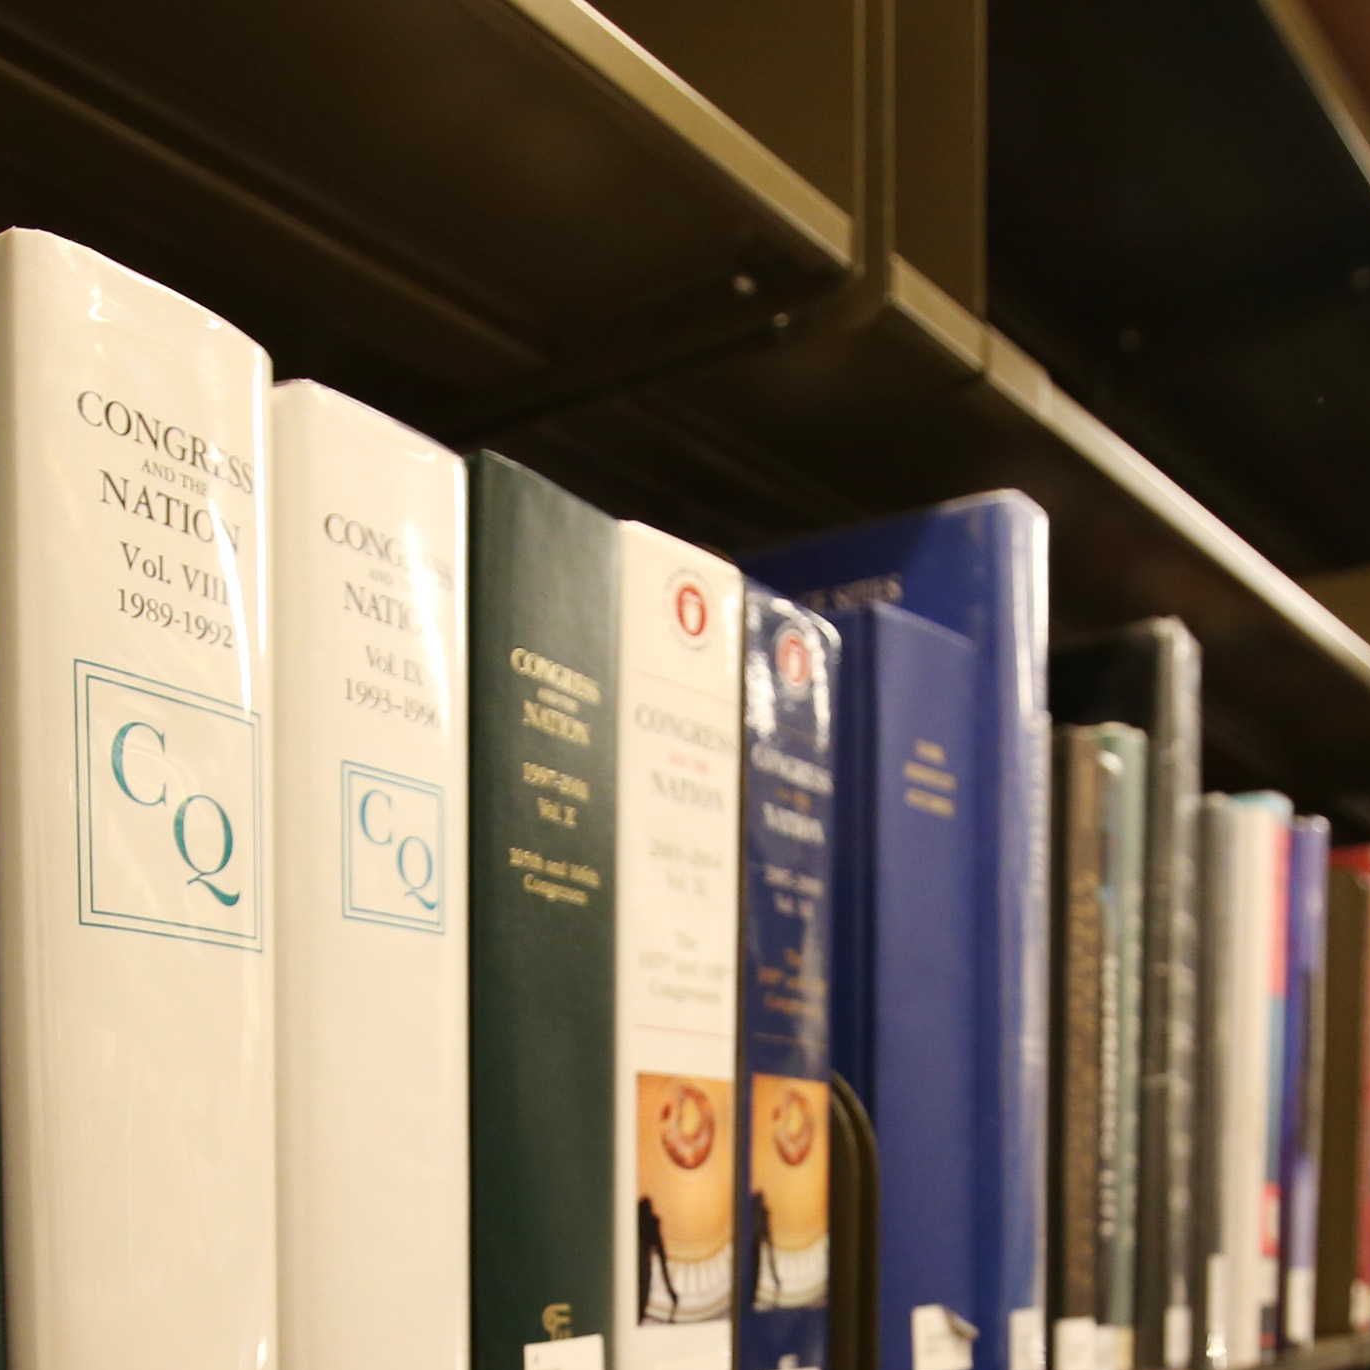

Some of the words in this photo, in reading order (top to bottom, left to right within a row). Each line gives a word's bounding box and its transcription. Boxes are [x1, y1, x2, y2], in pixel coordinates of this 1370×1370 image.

[141, 458, 175, 483] AND
[180, 472, 208, 496] THE
[119, 540, 171, 585] Vol.
[181, 563, 229, 606] VIII
[117, 587, 233, 649] 1989-1992
